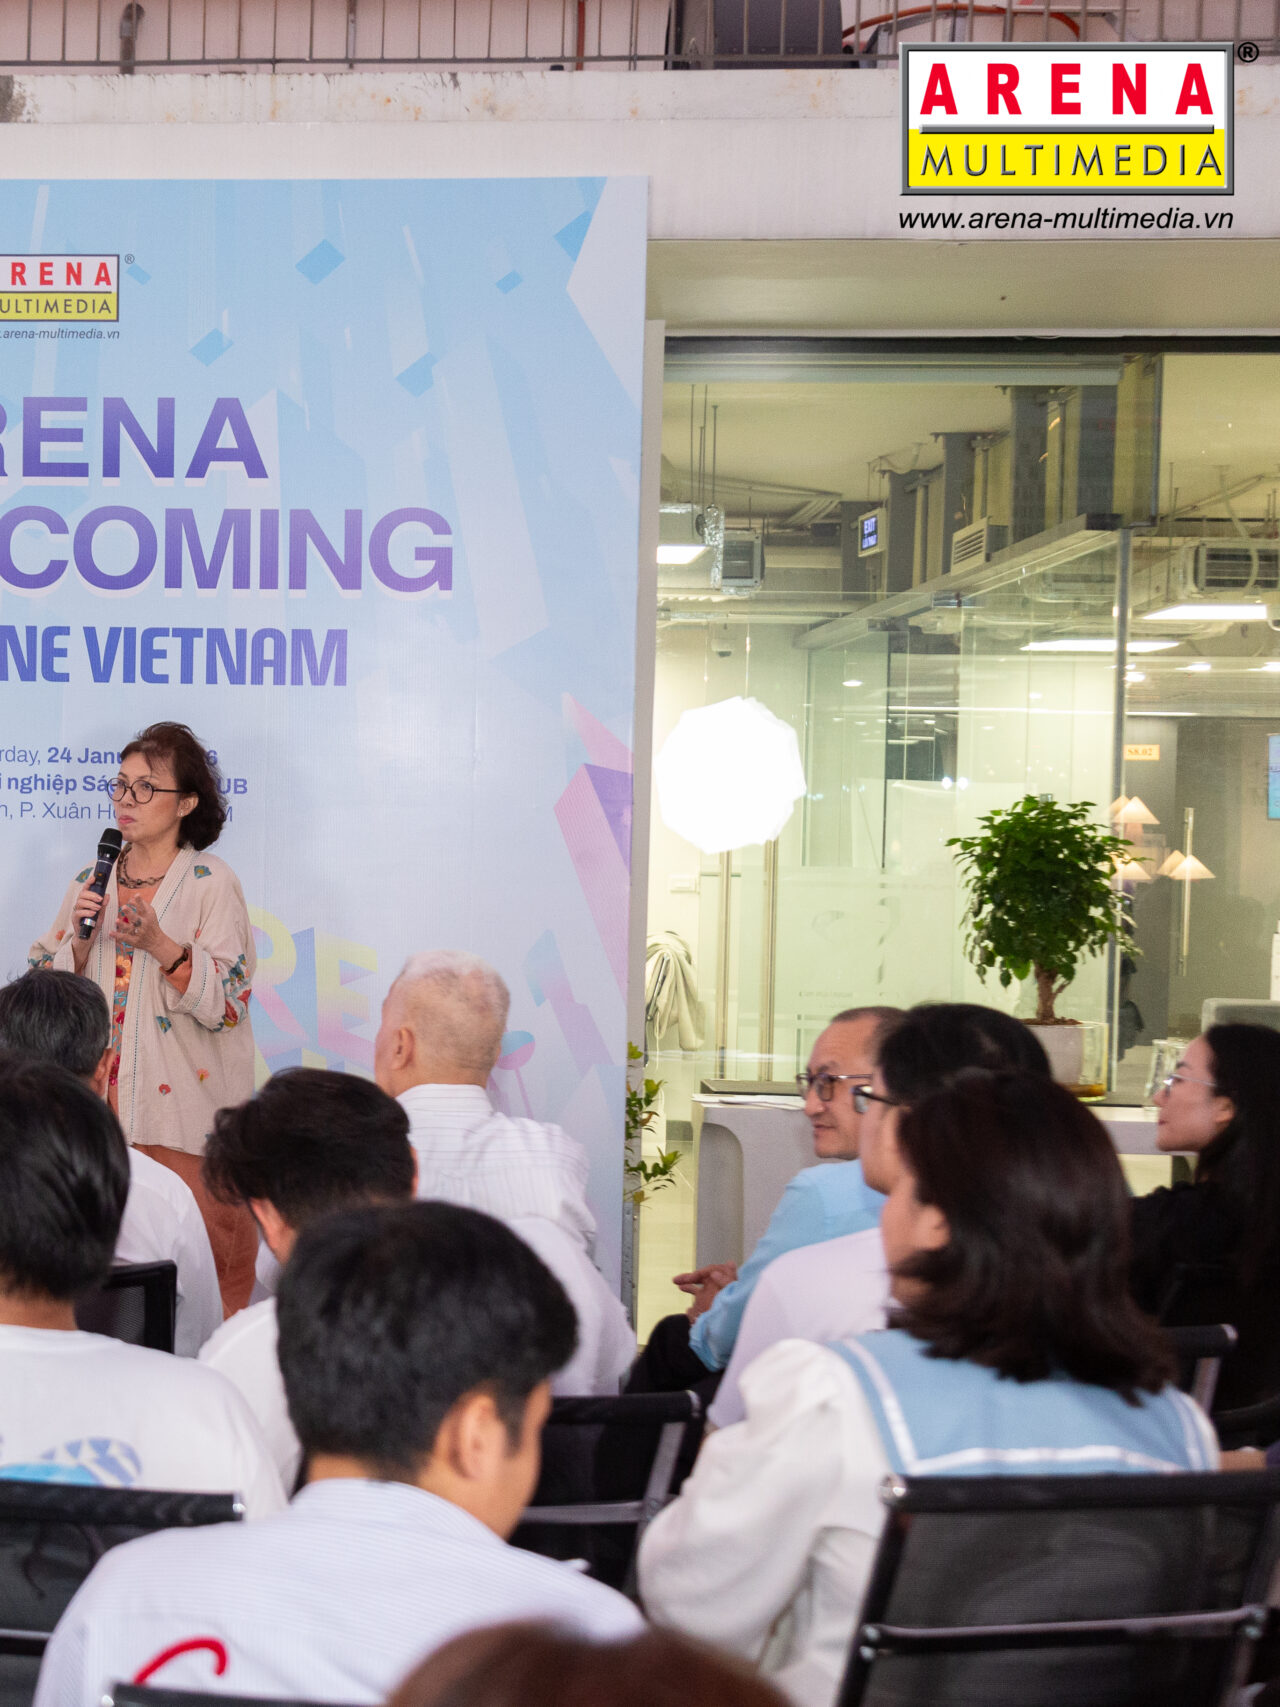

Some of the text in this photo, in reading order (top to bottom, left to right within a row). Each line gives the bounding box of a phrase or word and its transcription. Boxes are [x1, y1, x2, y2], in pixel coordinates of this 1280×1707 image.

[82, 625, 349, 687] VIETNAM
[47, 746, 72, 764] 24
[7, 773, 77, 795] nghiệp
[20, 801, 36, 818] P.
[42, 801, 91, 819] Xuân
